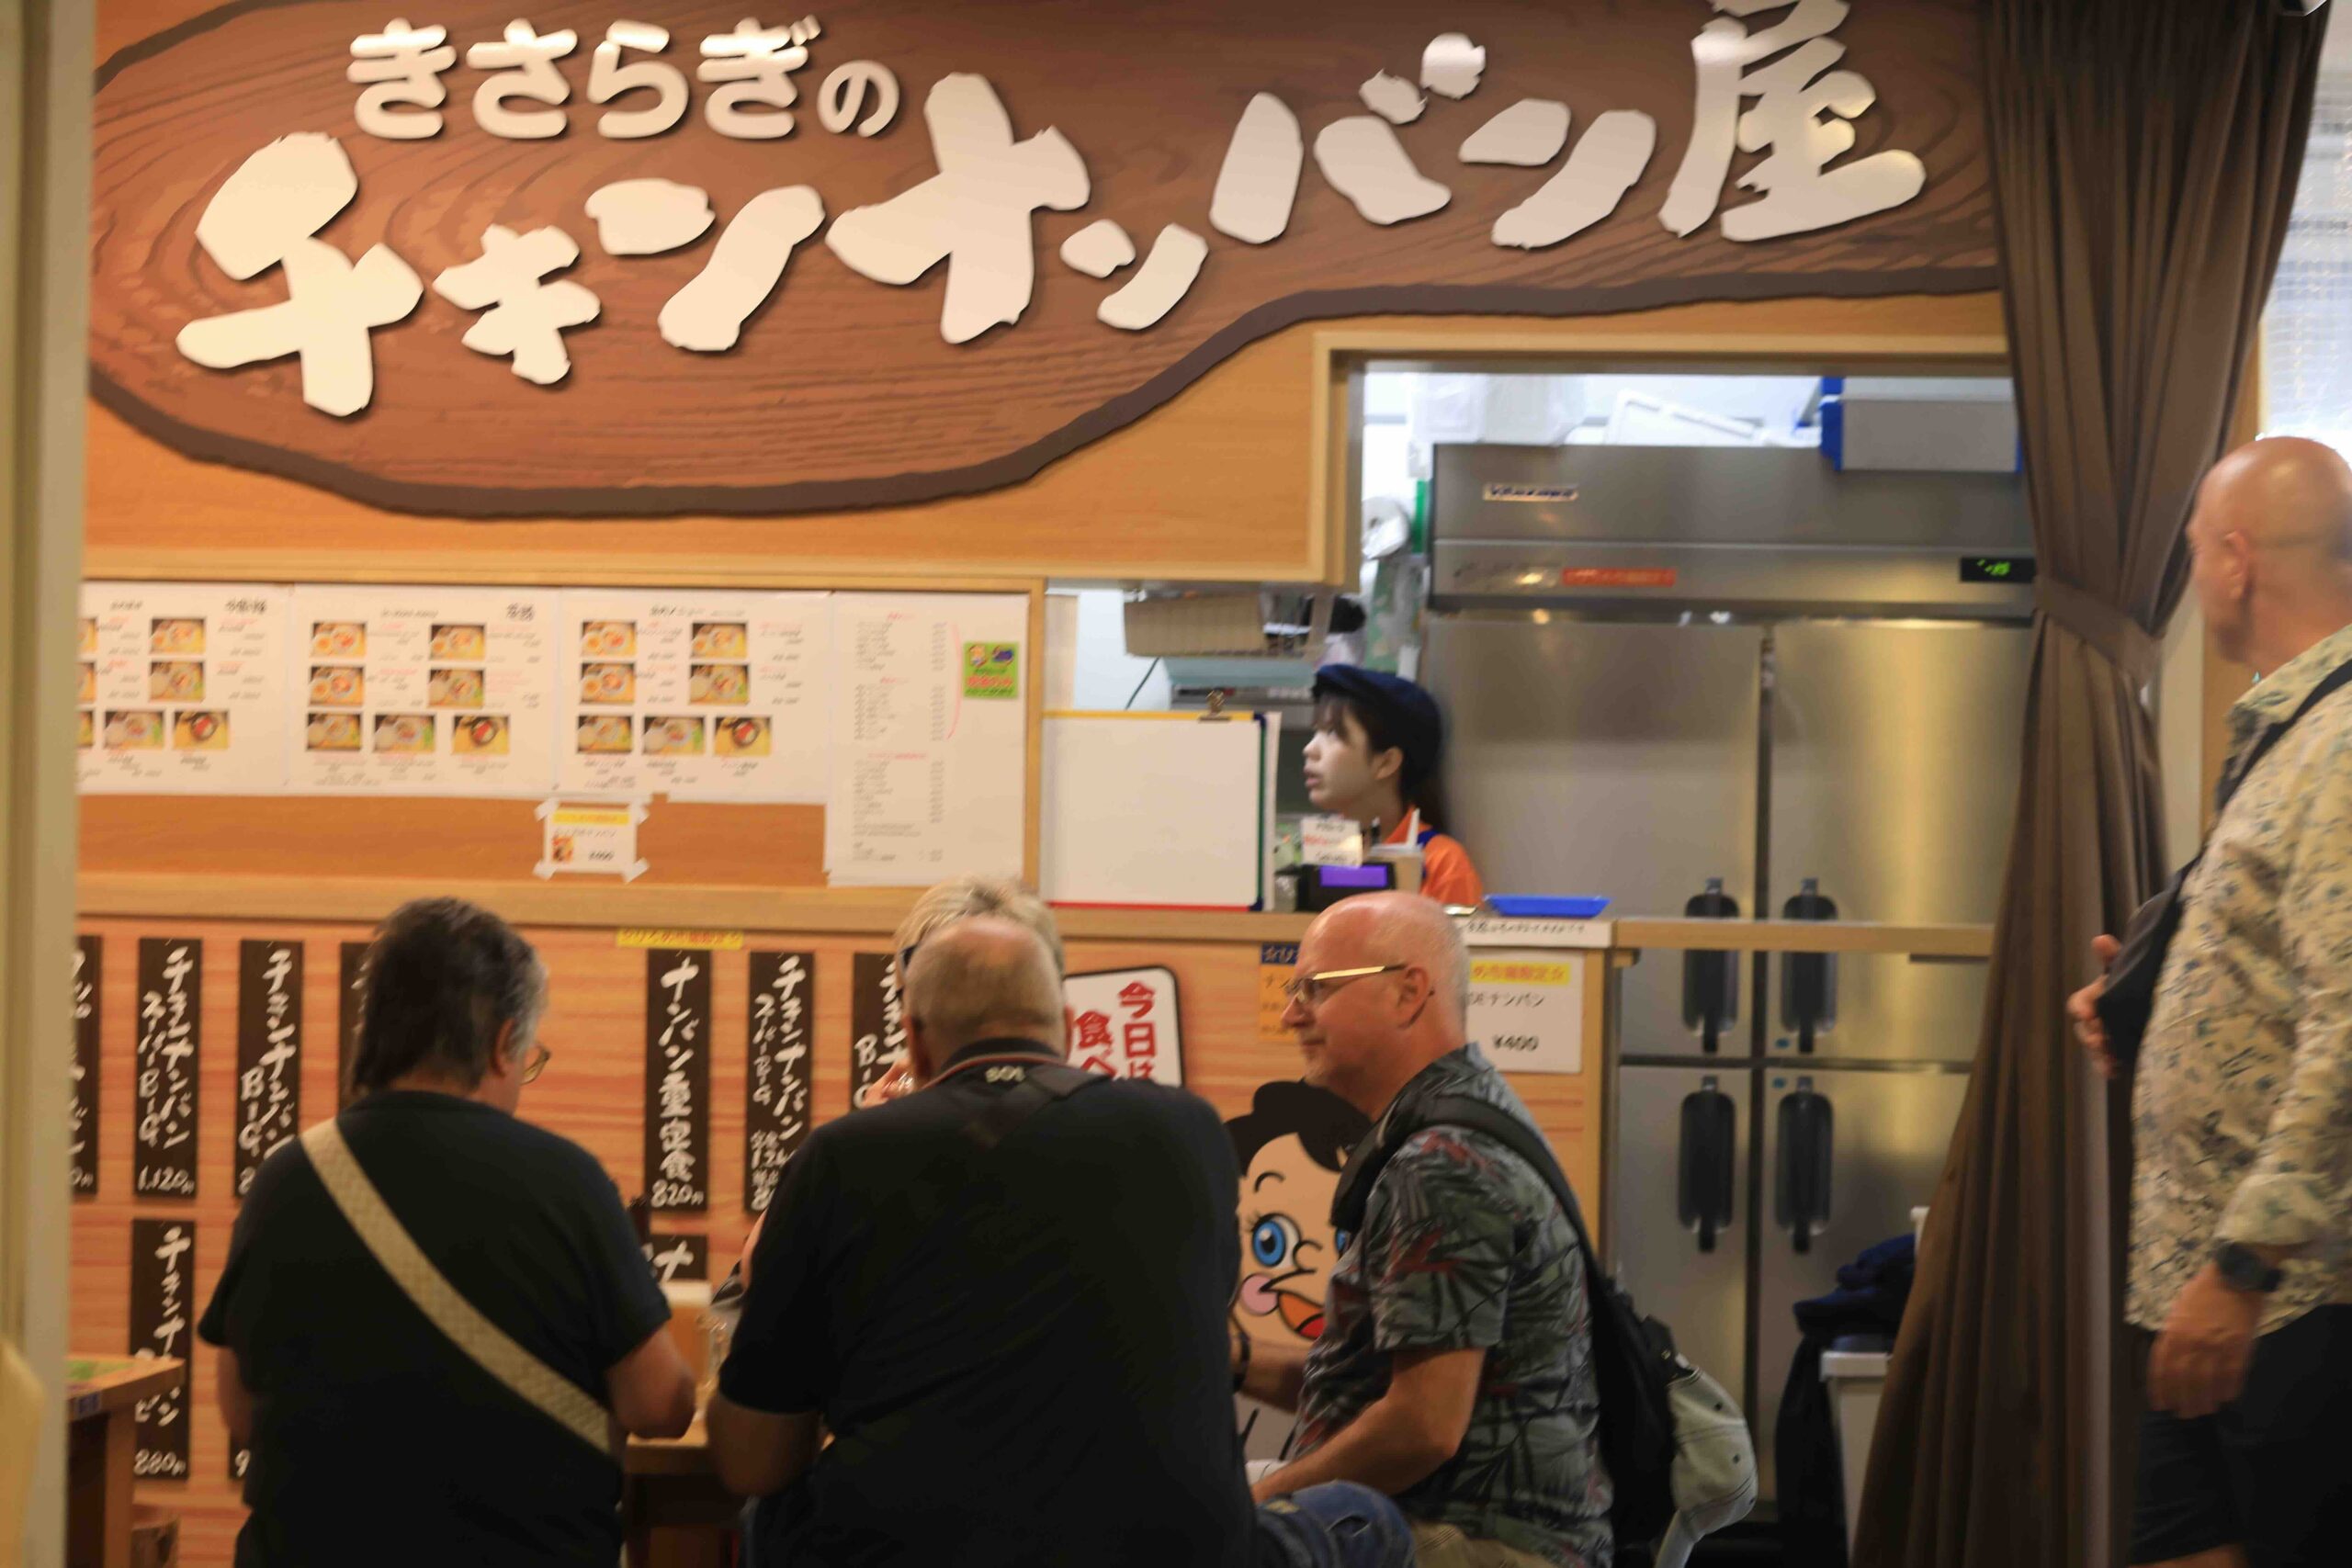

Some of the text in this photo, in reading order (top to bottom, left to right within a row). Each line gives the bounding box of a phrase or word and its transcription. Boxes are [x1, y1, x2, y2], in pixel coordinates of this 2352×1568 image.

[346, 16, 899, 140] きさらぎの
[176, 0, 1927, 417] チキンナンバン屋
[162, 946, 195, 1149] チキンナンバン
[239, 1066, 266, 1157] BIG
[258, 949, 298, 1160] チキンナンバン
[659, 956, 699, 1182] ナンバン重定食
[773, 955, 807, 1141] チキンナンバン
